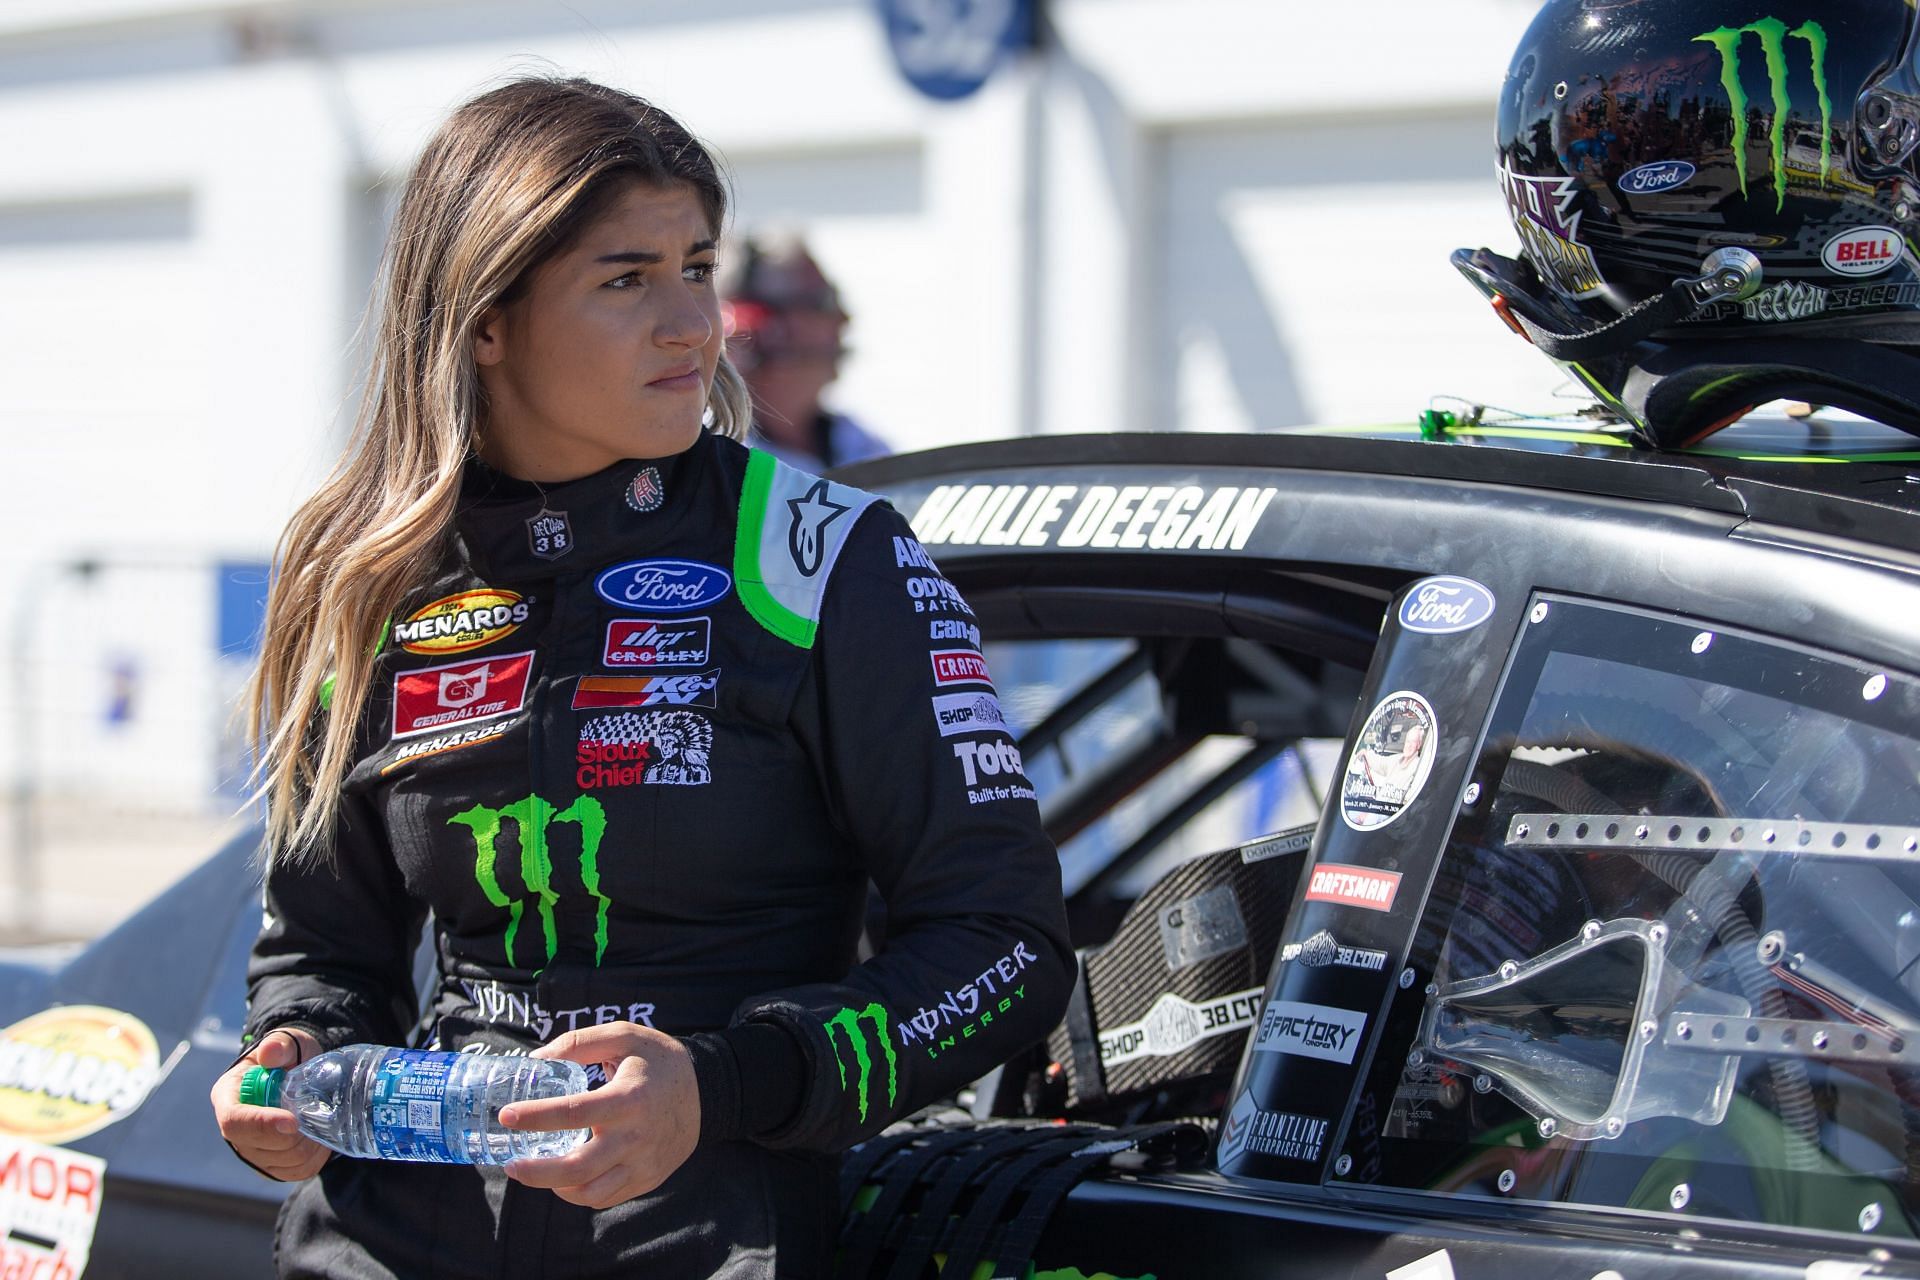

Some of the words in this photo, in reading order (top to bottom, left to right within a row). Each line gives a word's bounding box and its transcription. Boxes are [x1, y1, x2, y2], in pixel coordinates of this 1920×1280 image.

[1632, 165, 1680, 190] Ford
[1835, 239, 1894, 262] BELL
[1743, 281, 1829, 321] DEEGAN
[910, 485, 1078, 547] HAILIE
[1057, 486, 1278, 550] DEEGAN
[536, 533, 566, 551] 38
[625, 569, 706, 603] Ford
[1408, 584, 1473, 624] Ford
[395, 603, 529, 643] MENARDS
[610, 650, 705, 662] CROSLEY
[412, 707, 474, 728] GENERAL
[475, 700, 508, 717] TIRE
[939, 707, 974, 725] SHOP
[395, 721, 509, 760] MENARDS
[576, 741, 649, 764] Sioux
[577, 763, 646, 789] Chief
[967, 787, 994, 805] Built
[994, 785, 1010, 800] for
[1311, 871, 1392, 903] CRAFTSMAN
[1334, 947, 1386, 971] 38.COM
[898, 940, 1037, 1046] MONSTER
[461, 980, 656, 1041] MONSTER
[927, 984, 1025, 1060] ENERGY
[1101, 1029, 1144, 1060] SHOP
[1273, 1014, 1356, 1052] FACTORY
[400, 1083, 421, 1094] REFUND
[421, 1085, 436, 1095] CASH
[436, 1086, 444, 1095] CA
[1251, 1111, 1328, 1145] FRONTLINE
[1245, 1135, 1301, 1158] ENTERPRISES
[1303, 1145, 1320, 1160] INC
